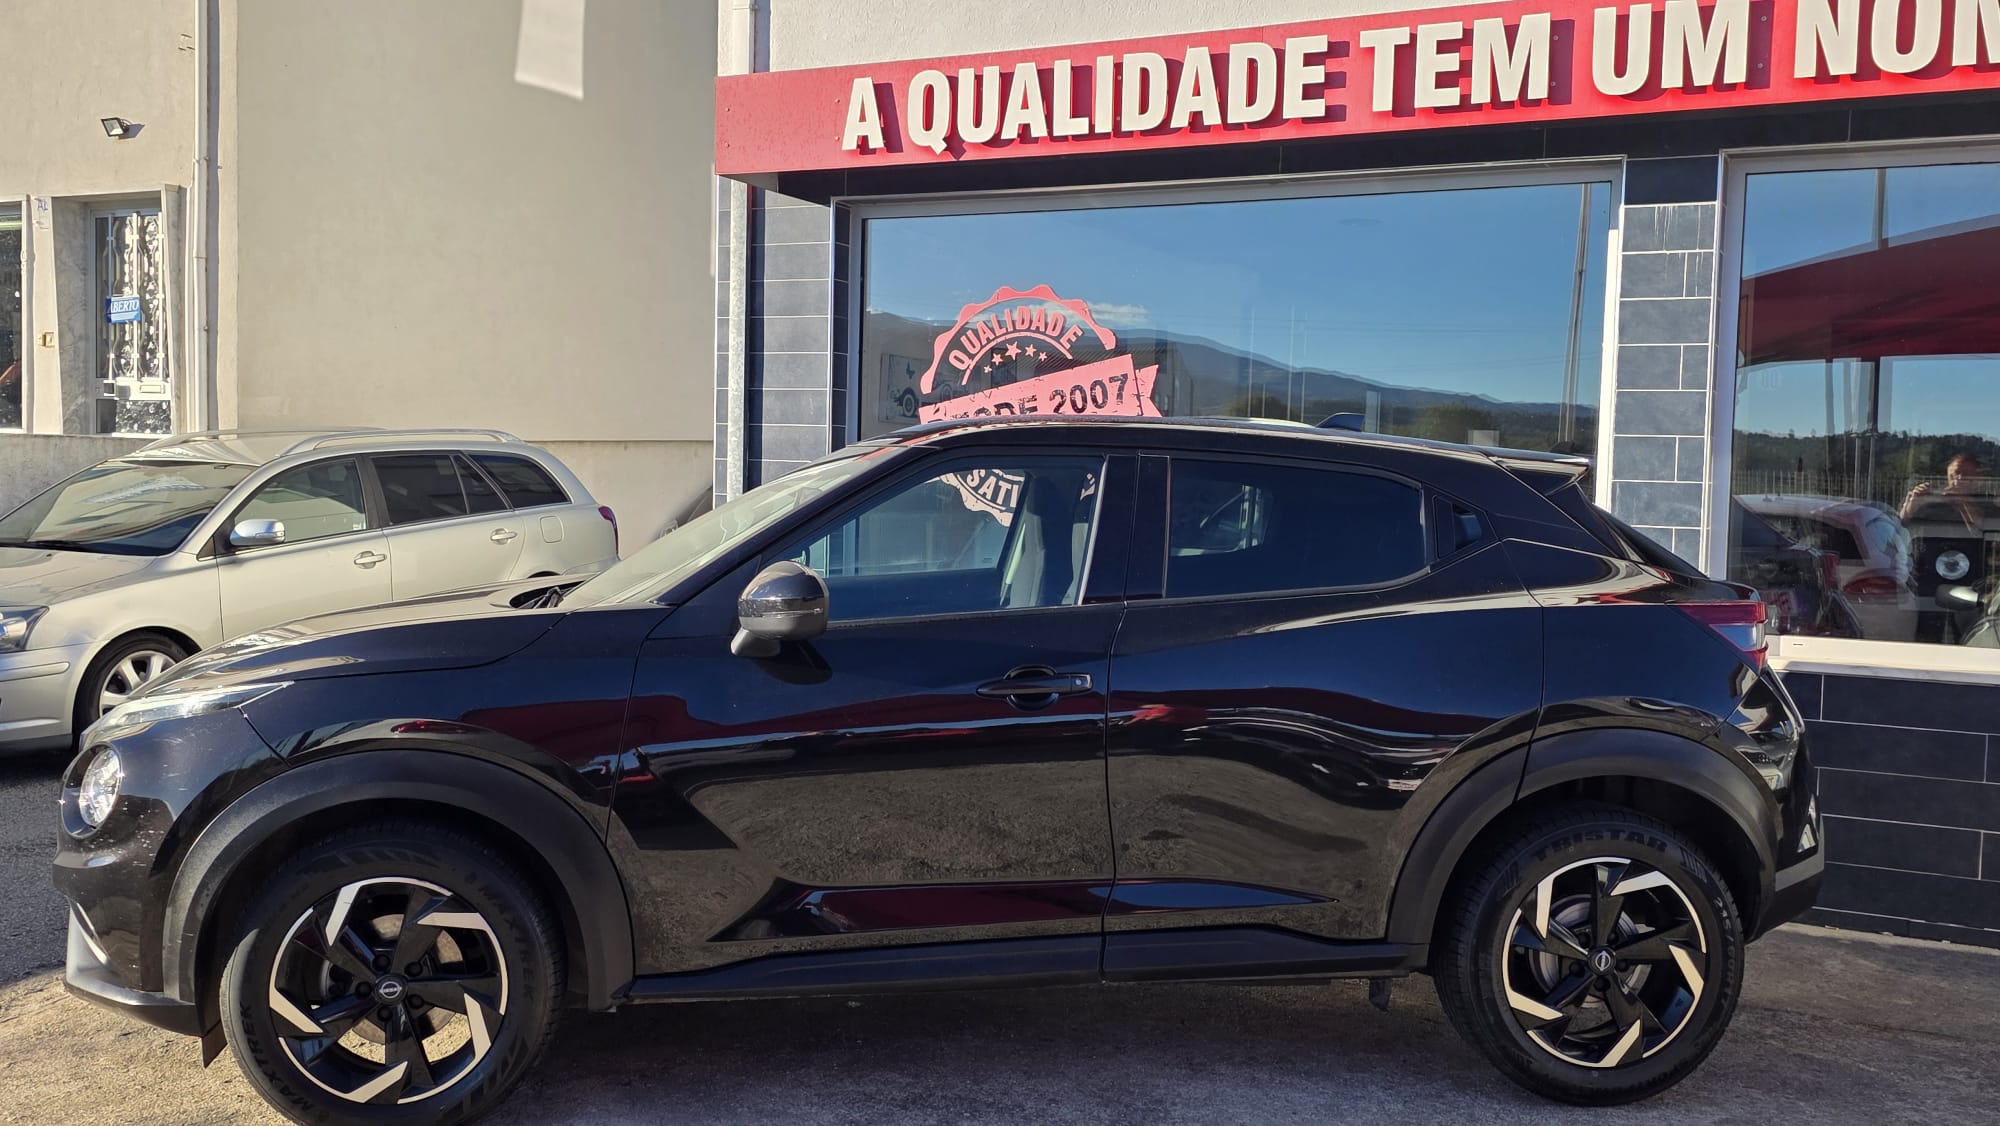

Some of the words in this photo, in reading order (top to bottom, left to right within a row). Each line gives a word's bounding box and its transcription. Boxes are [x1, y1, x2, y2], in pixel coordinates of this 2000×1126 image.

[841, 76, 886, 152] A
[906, 35, 1328, 155] QUALIDADE
[1358, 14, 1551, 112] TEM
[1592, 0, 1750, 96] UM
[948, 305, 1083, 370] QUALIDADE
[1049, 373, 1129, 414] 2007
[1532, 829, 1667, 859] TRISTAR
[239, 1000, 316, 1112] MAXTREK
